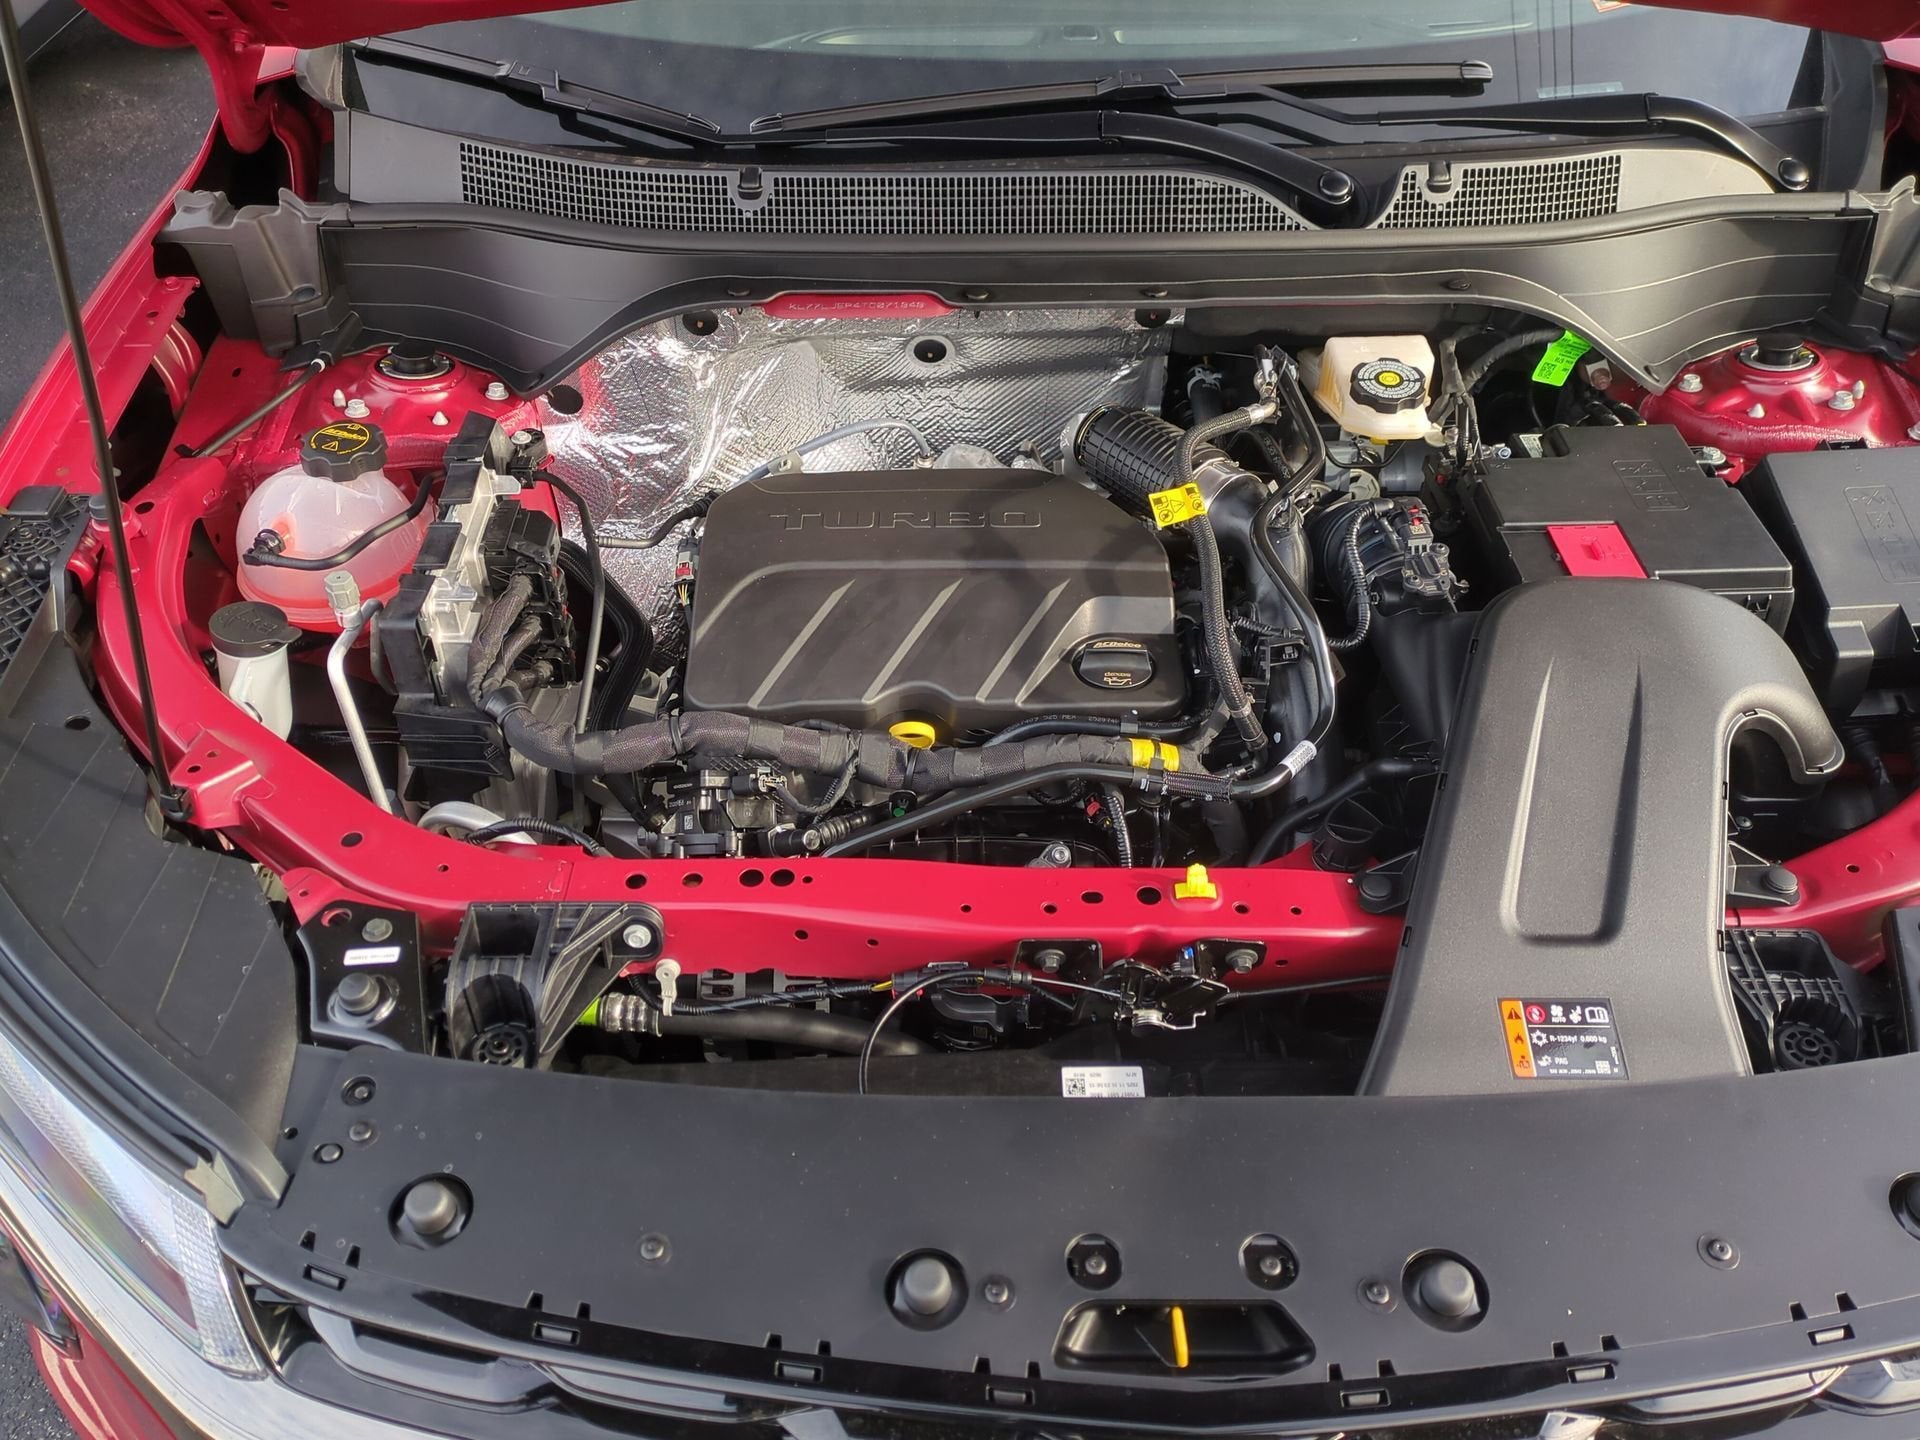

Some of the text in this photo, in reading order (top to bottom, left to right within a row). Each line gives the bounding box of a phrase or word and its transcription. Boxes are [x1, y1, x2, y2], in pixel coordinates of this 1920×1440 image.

[769, 511, 1041, 530] TURBO
[1093, 641, 1142, 649] ACDelco
[1599, 1035, 1608, 1044] kg
[1554, 1057, 1569, 1065] PAG
